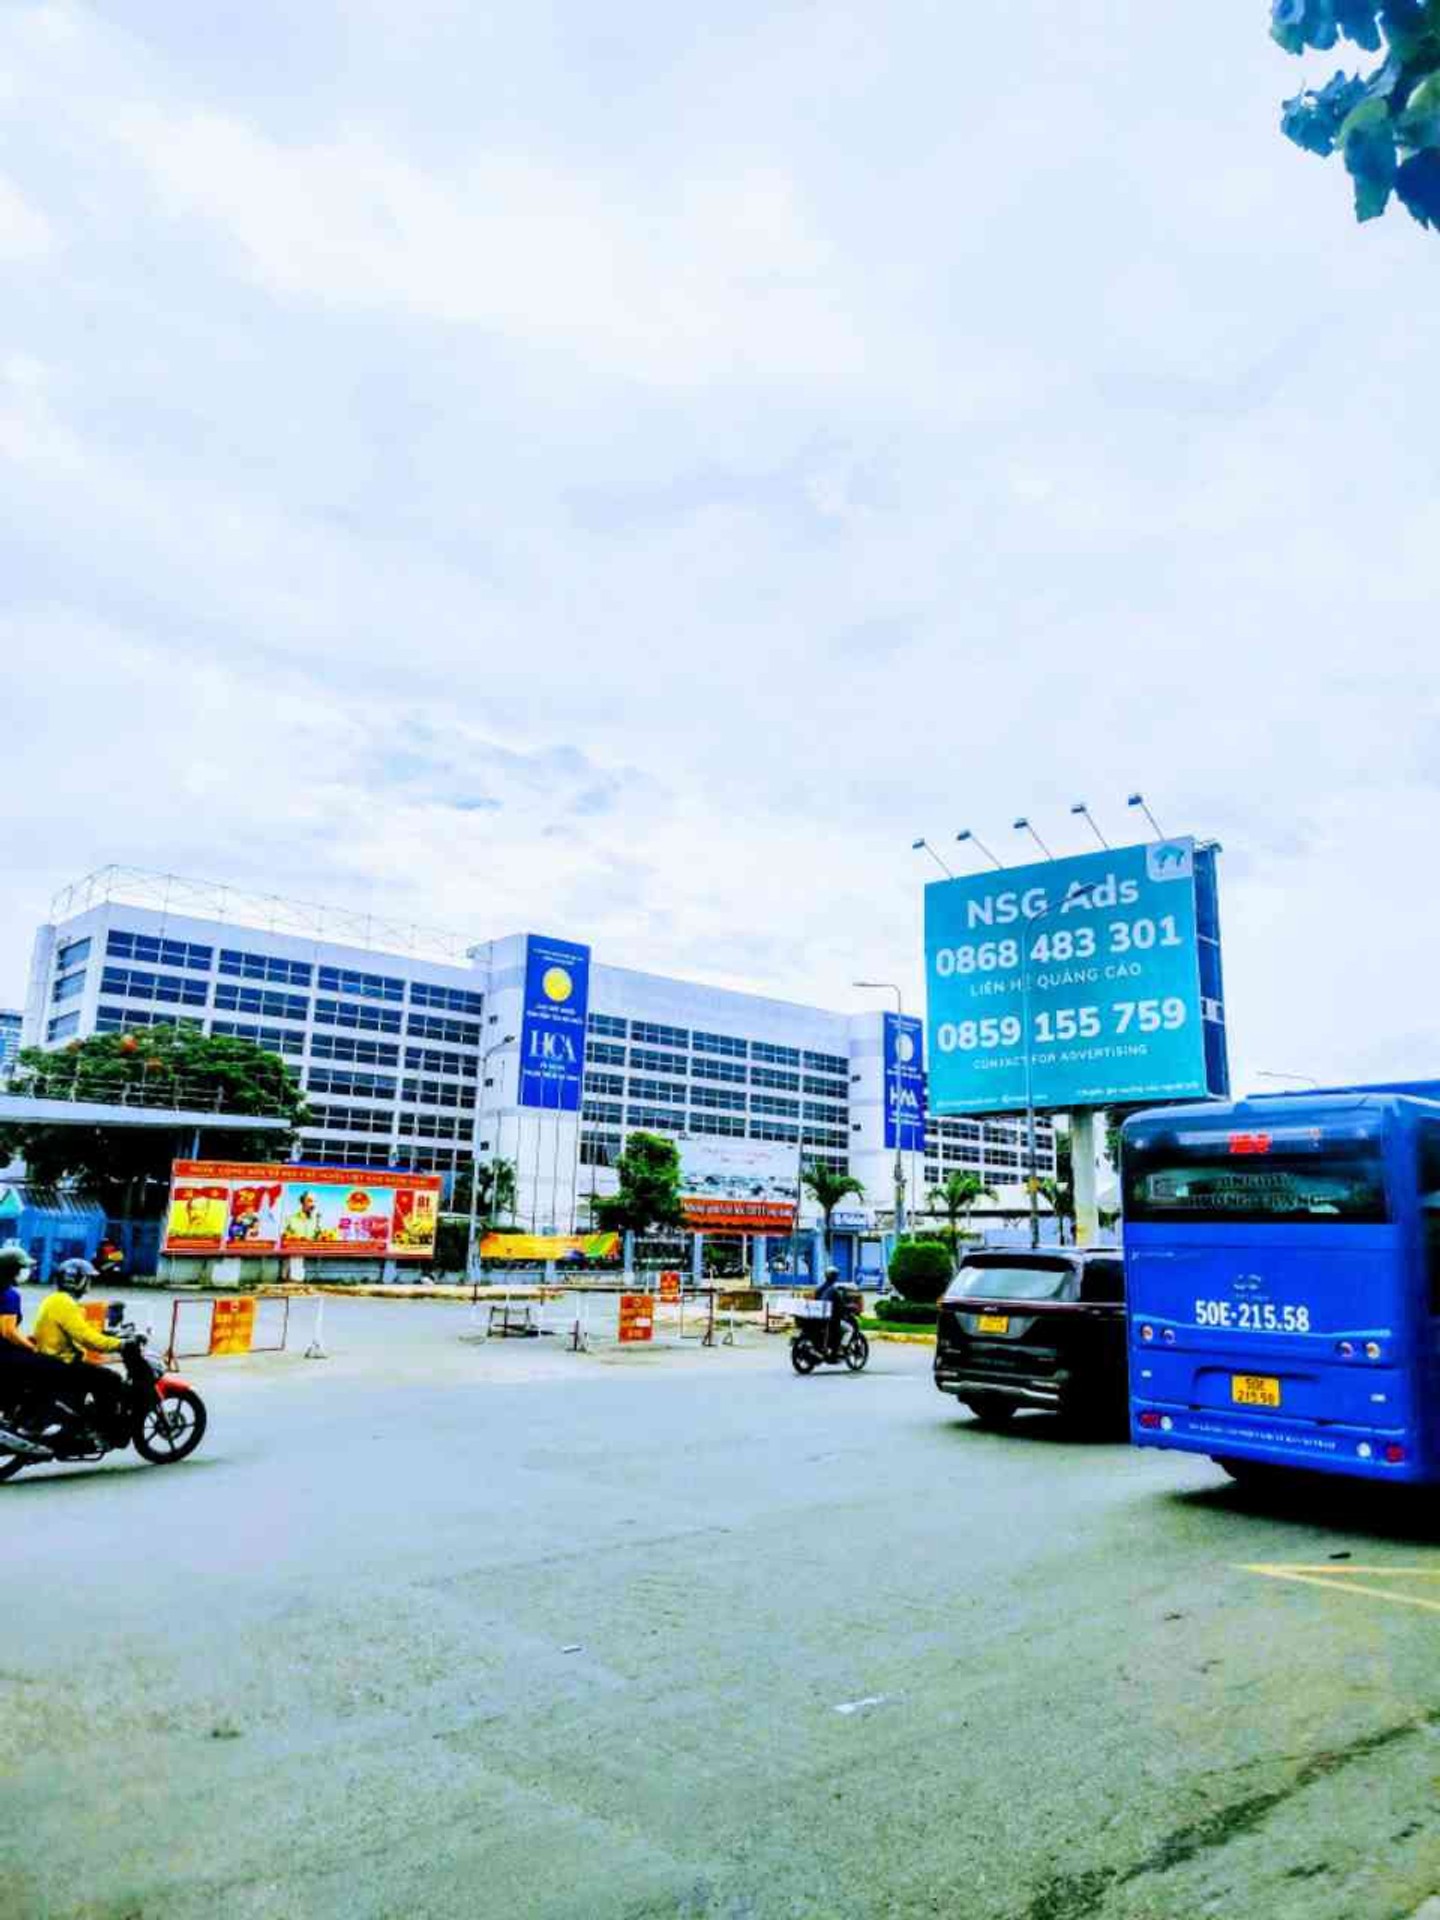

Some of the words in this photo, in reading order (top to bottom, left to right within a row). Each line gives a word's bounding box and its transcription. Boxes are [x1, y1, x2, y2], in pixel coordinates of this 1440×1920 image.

[967, 887, 1049, 929] NSG
[1060, 873, 1140, 914] Ads
[936, 939, 1018, 977] 0868
[1030, 928, 1096, 963] 483
[1109, 915, 1182, 953] 301
[970, 979, 1005, 998] LIÊN
[937, 1016, 1021, 1053] 0859
[1033, 1006, 1101, 1043] 155
[1113, 997, 1187, 1034] 759
